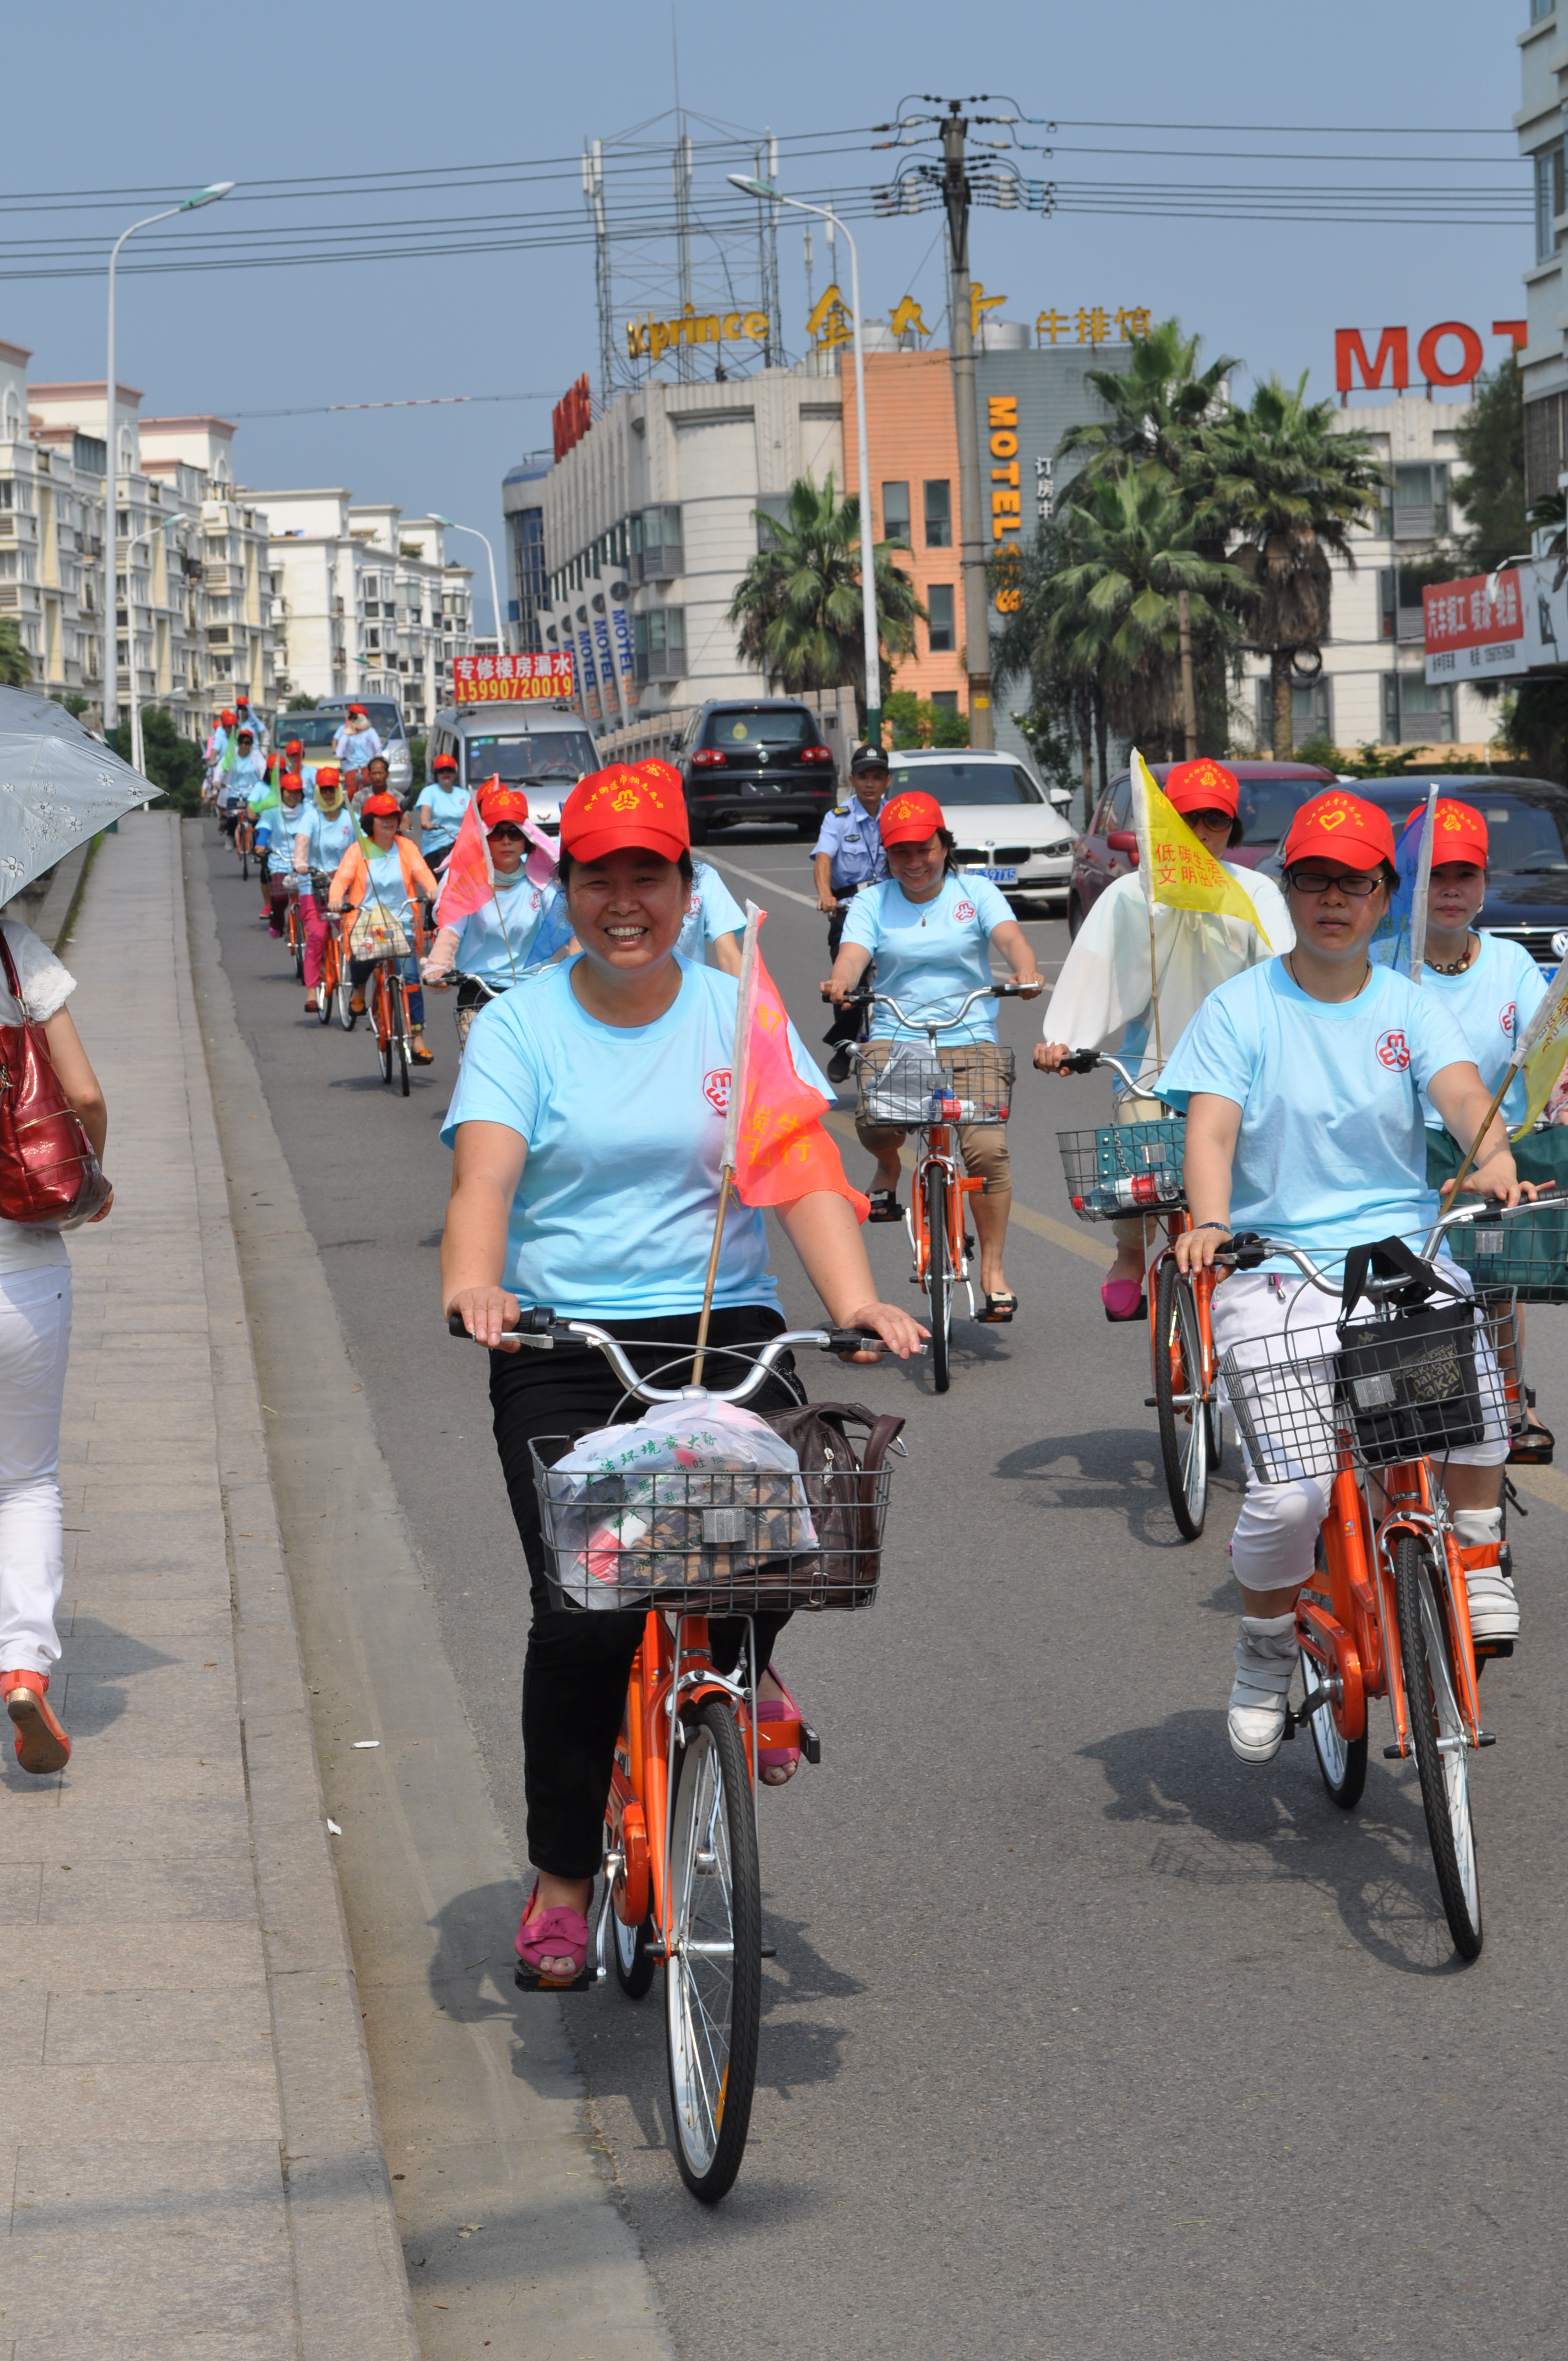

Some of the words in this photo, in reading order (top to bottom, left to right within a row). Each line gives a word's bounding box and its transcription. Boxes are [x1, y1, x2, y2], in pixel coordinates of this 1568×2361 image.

[1036, 306, 1151, 344] 牛排馆
[988, 396, 1021, 540] MOTEL
[594, 620, 613, 683] MOTEL
[612, 609, 633, 674] MOTEL
[457, 655, 571, 681] 专修楼房漏水
[579, 630, 596, 691] MOTEL
[458, 677, 571, 701] 15990720019
[1156, 844, 1221, 874] 低碳生活
[1157, 866, 1230, 890] 文明出行
[758, 1005, 782, 1035] 87
